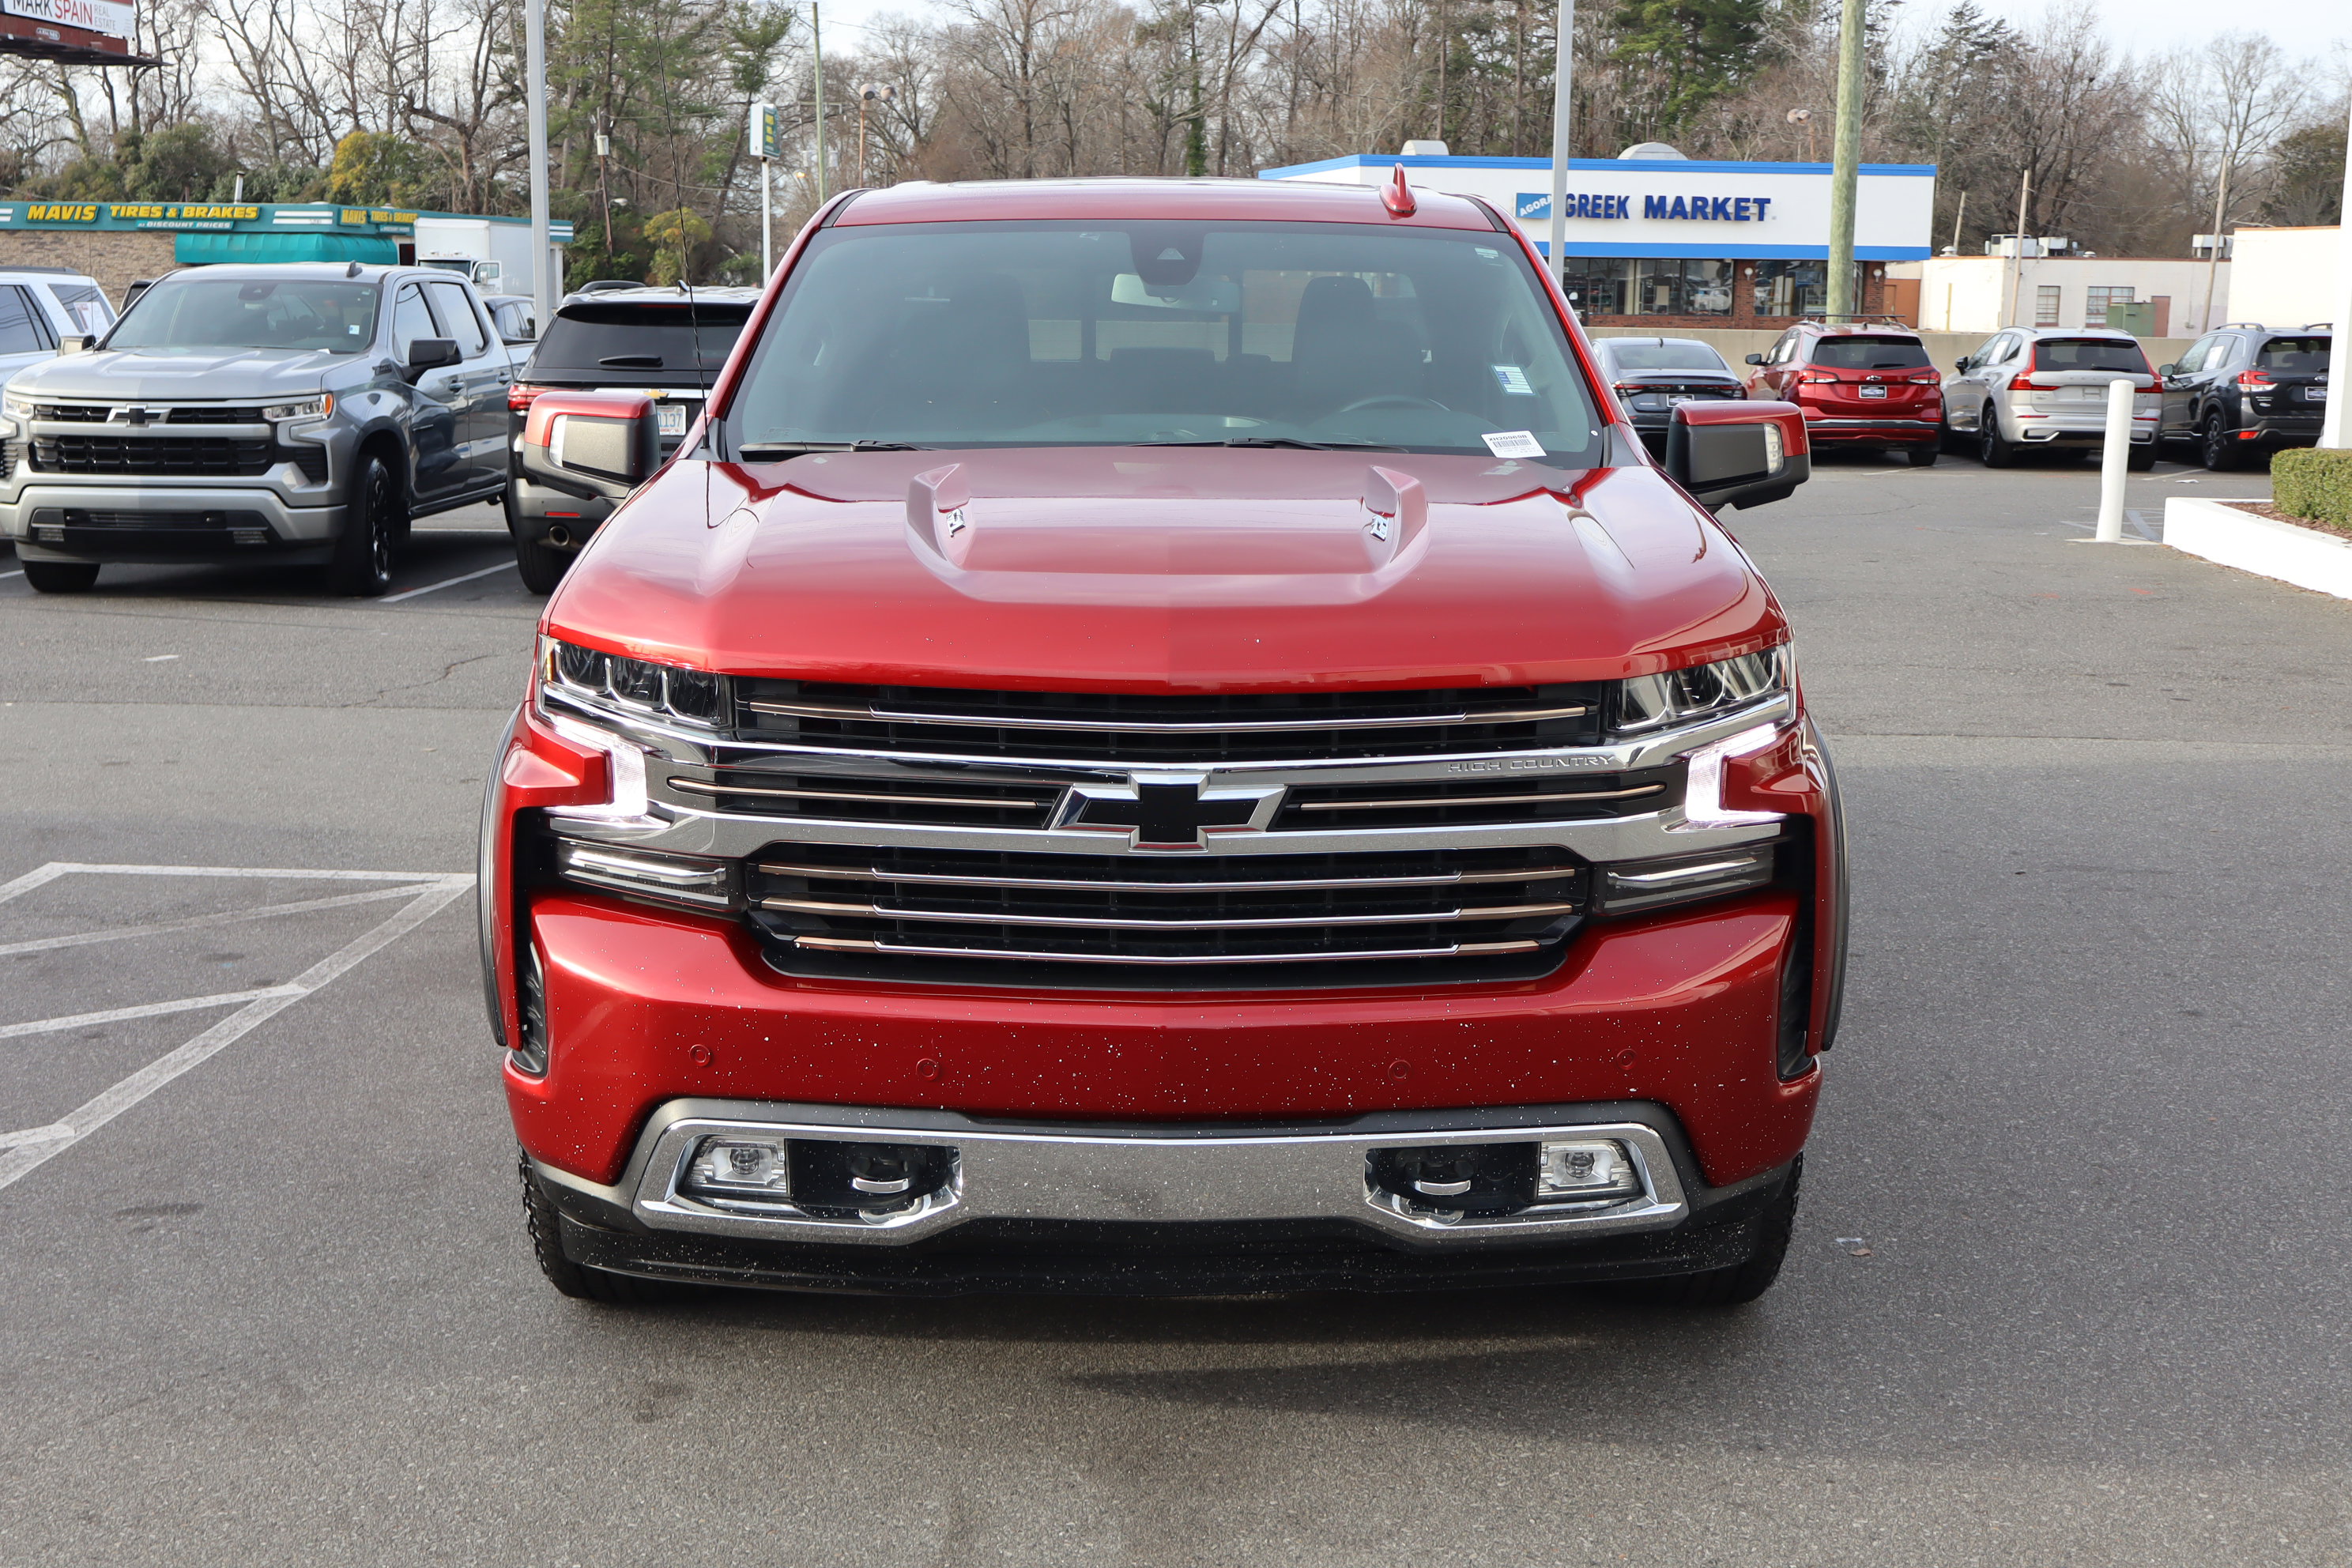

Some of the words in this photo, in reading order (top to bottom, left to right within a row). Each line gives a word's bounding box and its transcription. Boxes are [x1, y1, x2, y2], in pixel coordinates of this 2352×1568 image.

[13, 0, 52, 17] MARK
[55, 0, 93, 25] SPAIN
[94, 4, 110, 17] REAL
[94, 17, 116, 31] ESTATE
[27, 205, 97, 221] MAVIS
[109, 205, 163, 219] TIRES
[166, 206, 179, 217] &
[182, 205, 258, 219] BRAKES
[1566, 193, 1630, 218] GREEK
[1644, 195, 1771, 221] MARKET
[341, 209, 367, 224] MAVIS
[1448, 761, 1502, 772] HIGH
[1510, 755, 1615, 770] COUNTRY
